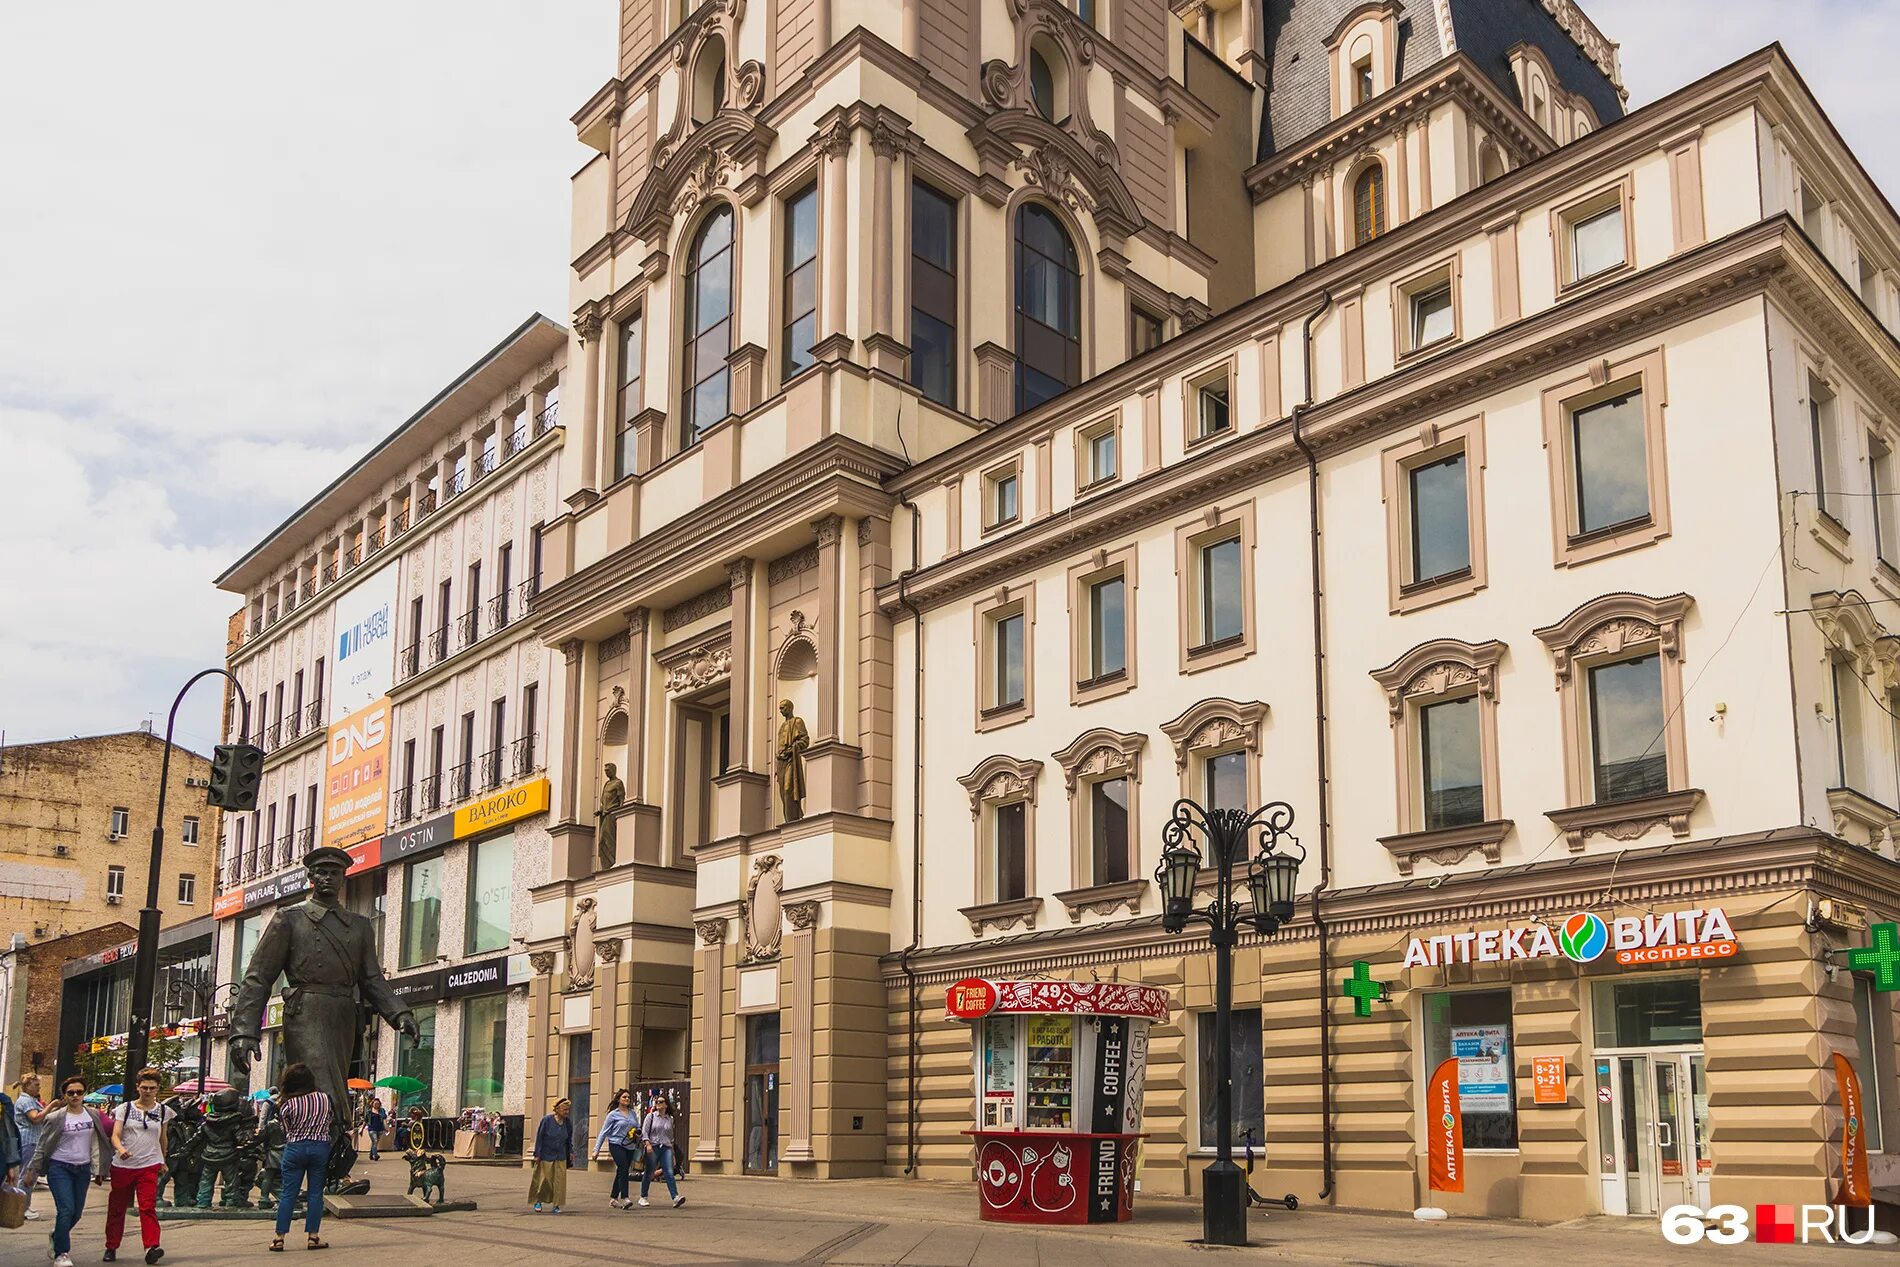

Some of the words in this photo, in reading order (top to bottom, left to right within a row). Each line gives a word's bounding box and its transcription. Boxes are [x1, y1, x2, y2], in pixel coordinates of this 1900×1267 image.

[331, 707, 386, 767] DNS
[468, 789, 527, 824] BAROKO
[400, 826, 434, 851] O'STIN
[280, 869, 305, 885] ИМПЕРИЯ
[283, 881, 301, 894] СУМОК
[257, 884, 275, 899] FLARE
[1402, 926, 1563, 969] АПТЕКА
[1613, 906, 1737, 951] ВИТА
[1619, 942, 1733, 962] ЭКСПРЕСС
[448, 967, 498, 988] CALZEDONIA
[966, 987, 986, 999] FRIEND
[1037, 984, 1061, 998] 49
[1143, 990, 1156, 1003] 49
[965, 998, 986, 1011] COFFEE
[1103, 1040, 1121, 1096] COFFEE
[1441, 1079, 1450, 1113] ВИТА
[1445, 1130, 1457, 1181] АПТЕКА
[1845, 1135, 1857, 1196] АПТЕКА
[1097, 1140, 1116, 1195] FRIEND
